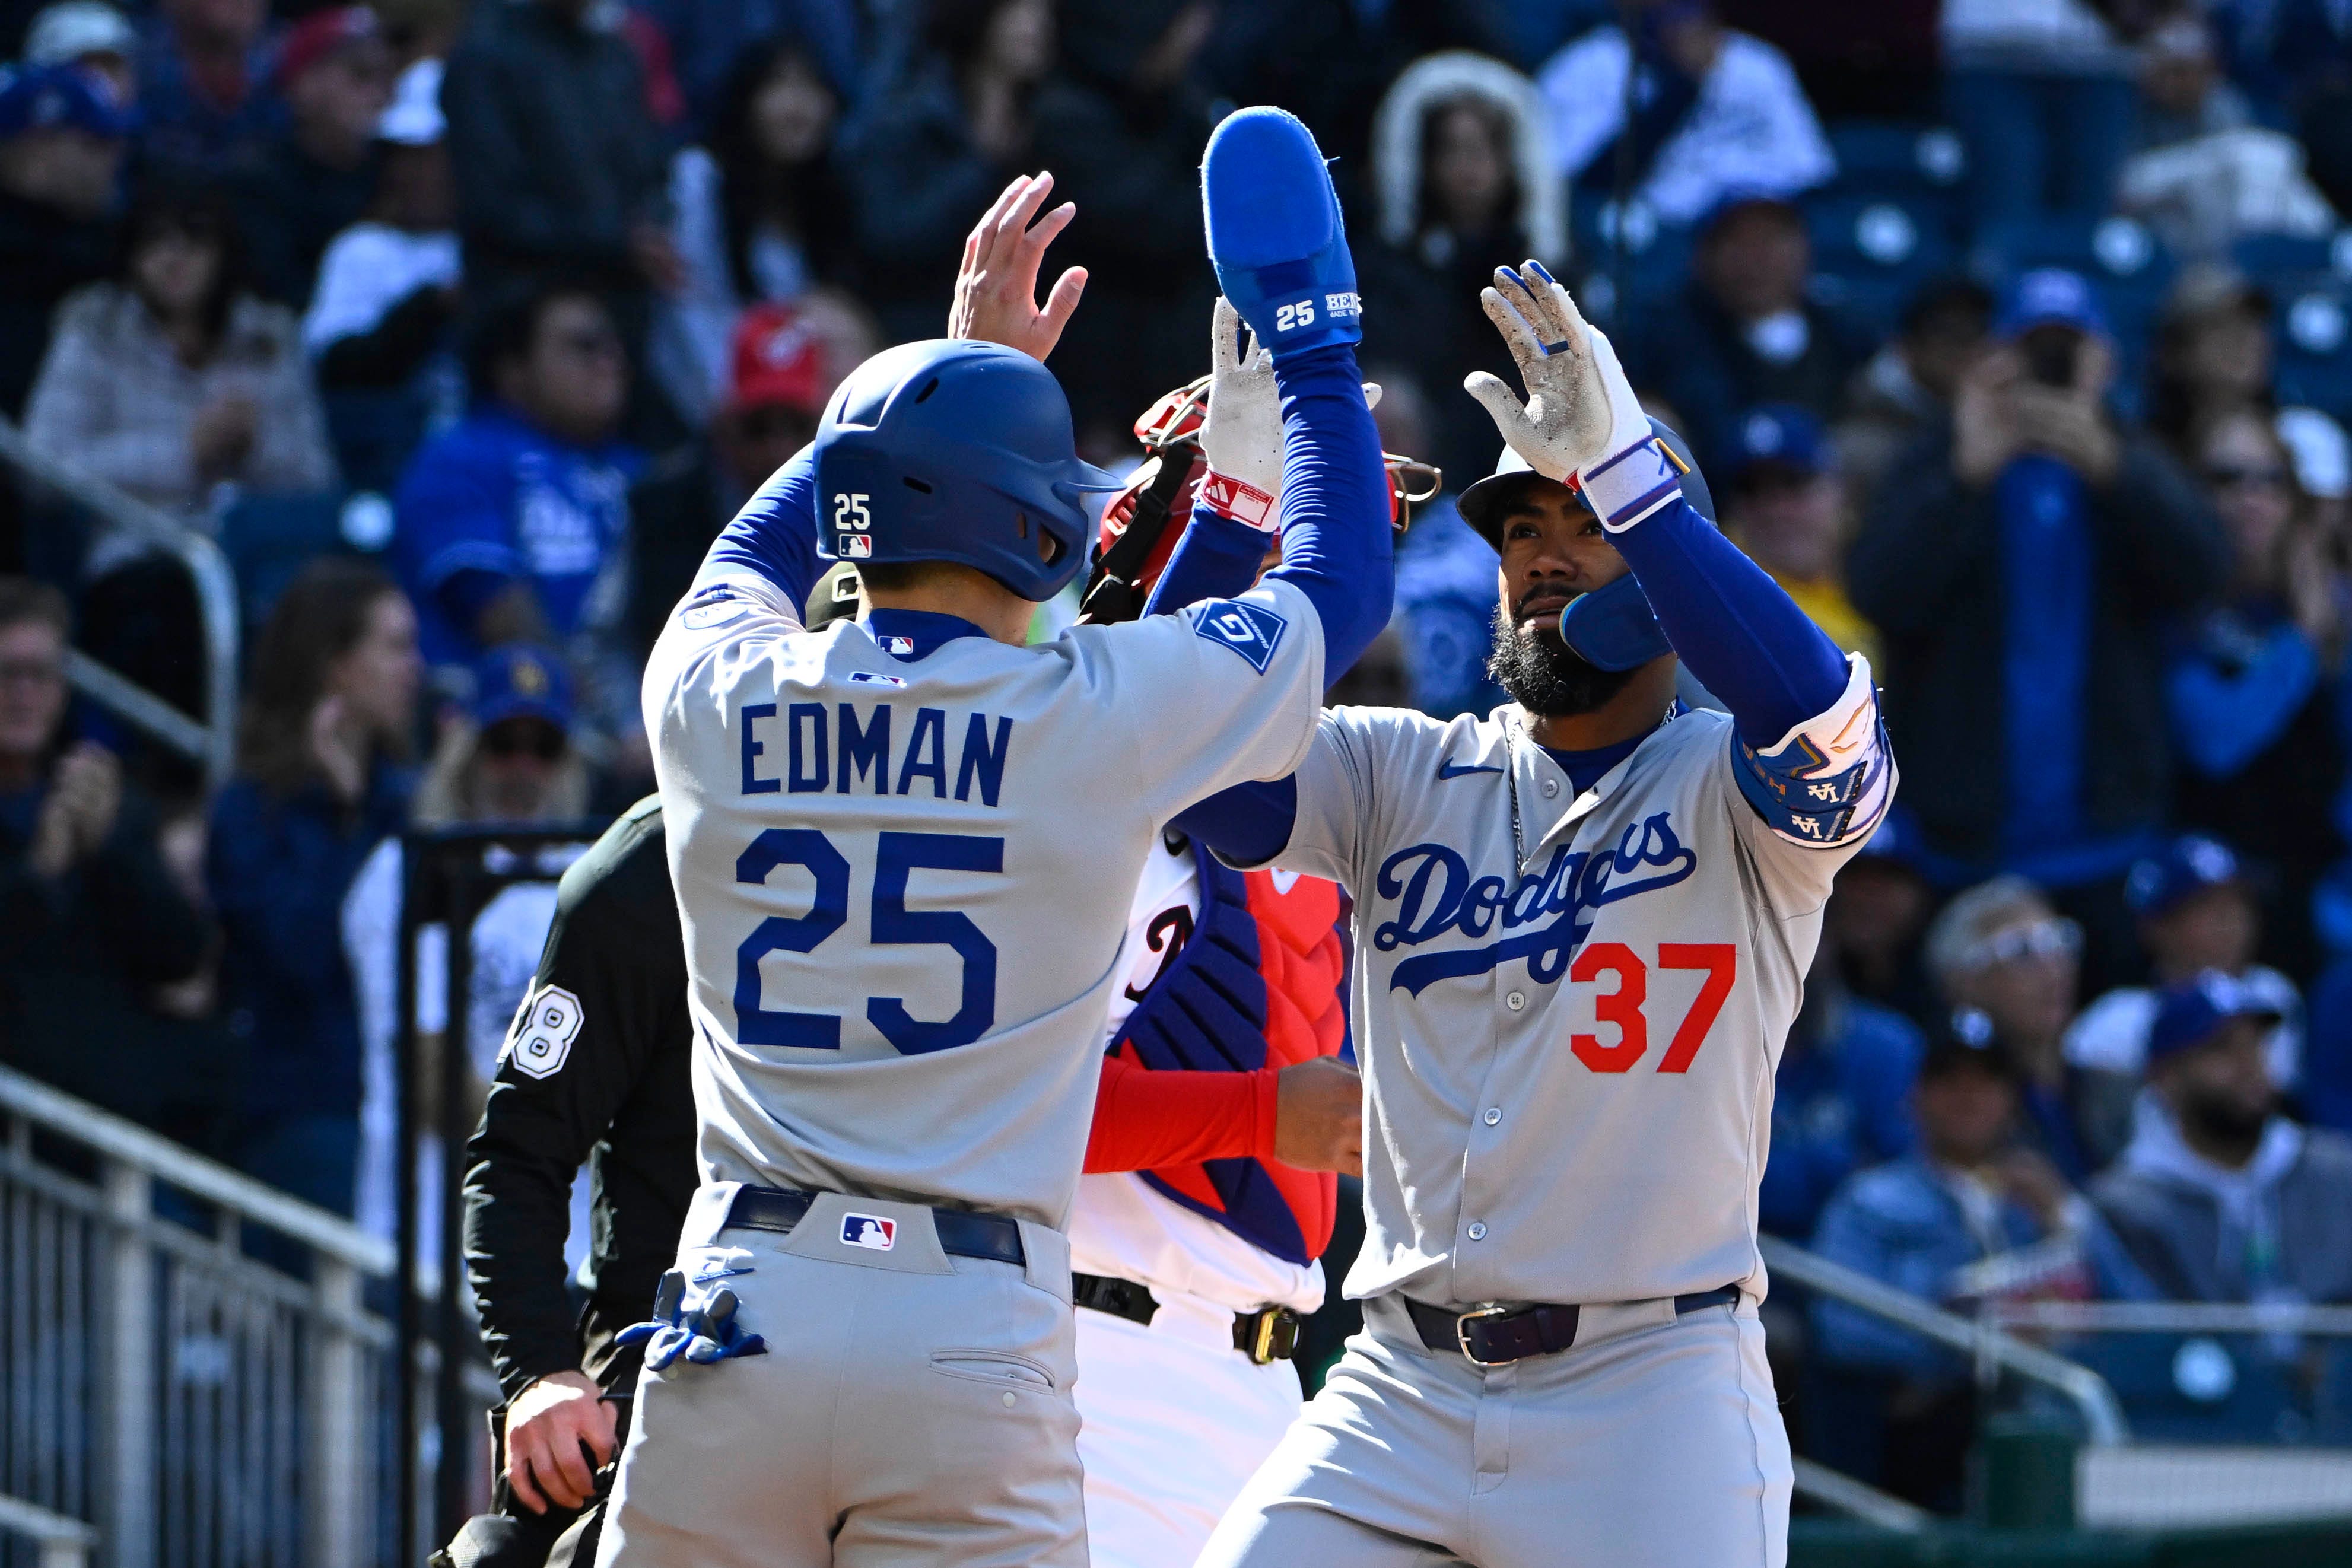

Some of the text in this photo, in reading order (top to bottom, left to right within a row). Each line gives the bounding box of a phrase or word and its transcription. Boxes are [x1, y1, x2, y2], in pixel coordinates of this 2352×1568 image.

[1277, 300, 1314, 332] 25
[834, 494, 870, 530] 25
[742, 702, 1013, 807] EDMAN
[1807, 783, 1840, 803] LA
[1792, 814, 1823, 839] LA
[733, 828, 1005, 1055] 25
[1374, 811, 1697, 992] Dodgers
[496, 976, 585, 1080] 8
[1570, 943, 1736, 1073] 37
